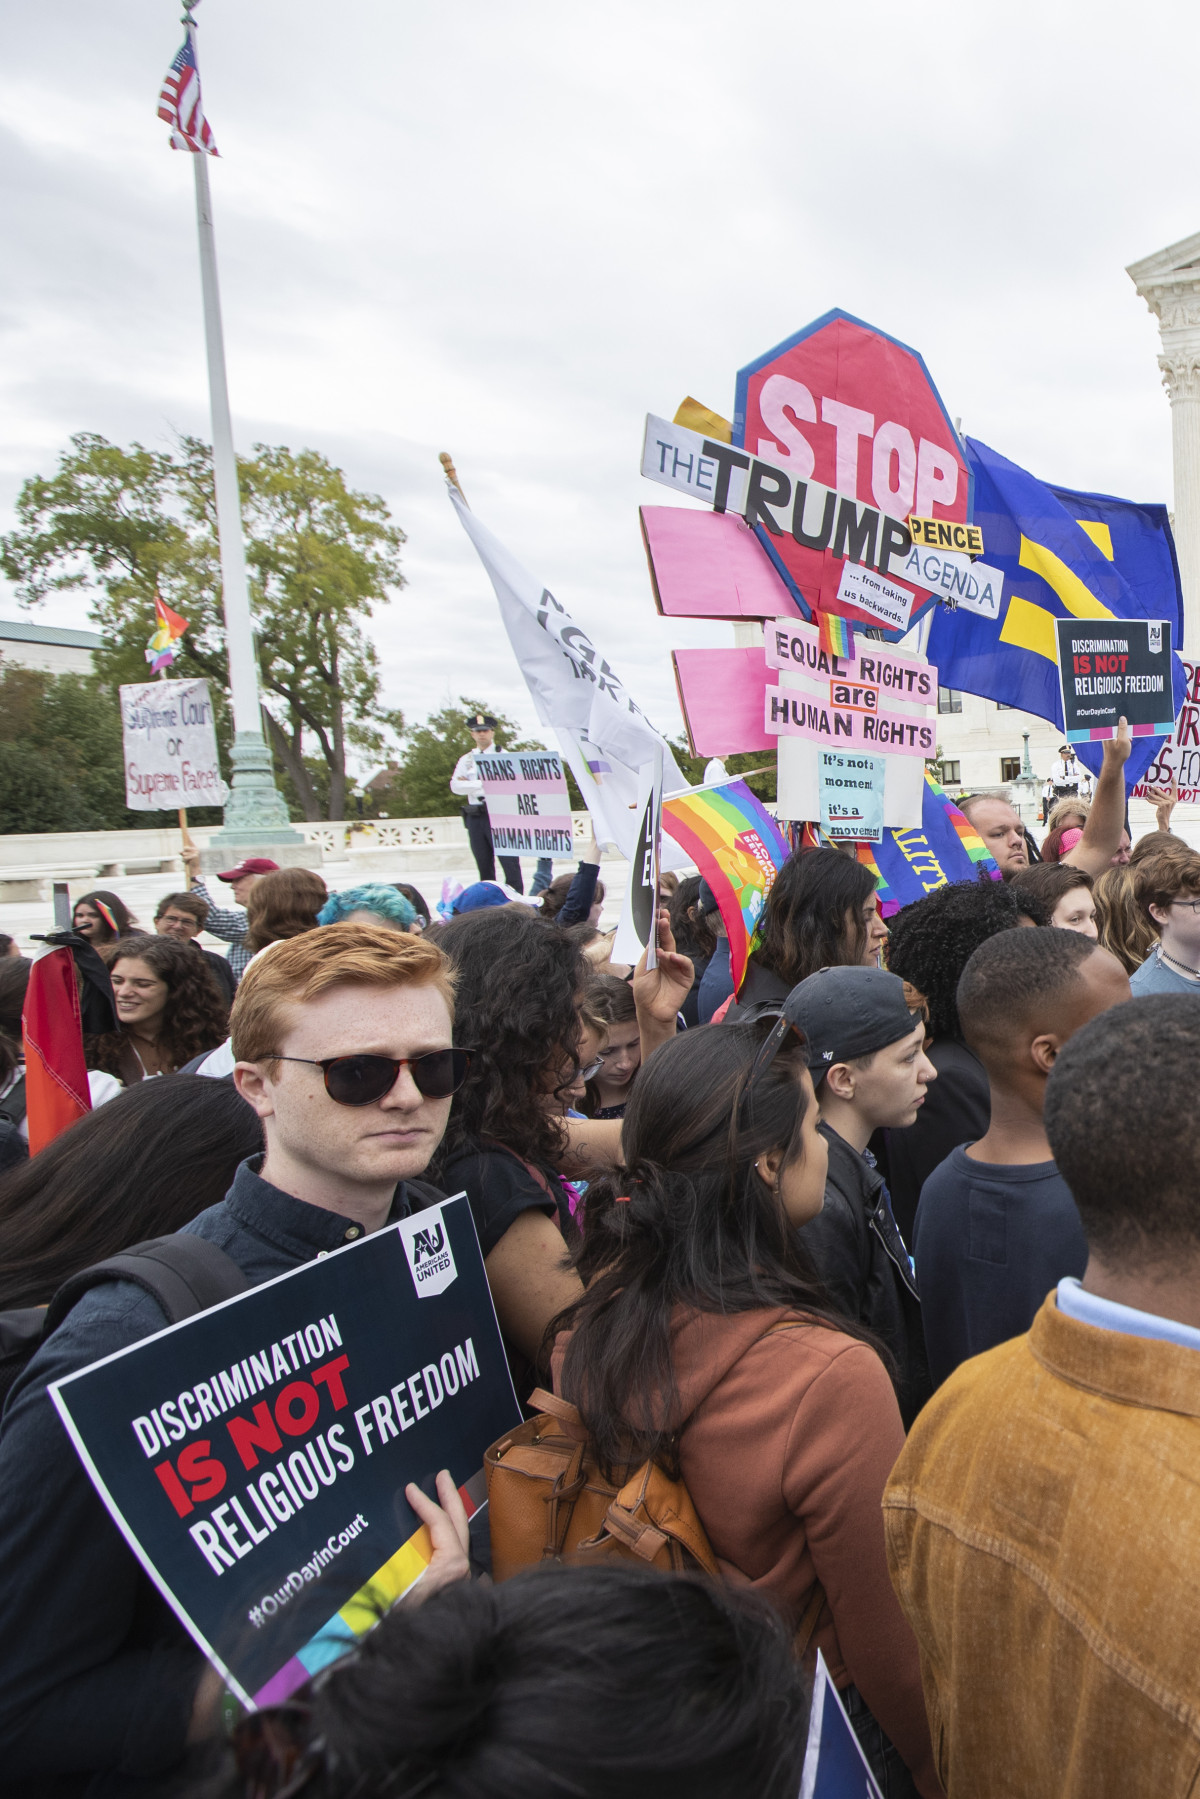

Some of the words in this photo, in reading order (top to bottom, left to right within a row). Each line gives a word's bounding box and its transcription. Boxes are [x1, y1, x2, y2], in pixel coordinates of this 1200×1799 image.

[757, 373, 959, 522] STOP
[656, 440, 715, 492] THE
[701, 439, 912, 575] TRUMP
[911, 518, 981, 551] PENCE
[905, 547, 995, 609] AGENDA
[844, 590, 857, 600] us
[862, 575, 880, 591] from
[882, 586, 908, 607] taking
[1072, 640, 1128, 653] DISCRIMINATION
[775, 630, 847, 678] EQUAL
[860, 656, 931, 695] RIGHTS
[1073, 655, 1091, 674] IS
[1095, 655, 1129, 673] NOT
[834, 685, 876, 708] are
[1075, 675, 1122, 696] RELIGIOUS
[1125, 675, 1164, 693] FREEDOM
[771, 696, 853, 737] HUMAN
[864, 716, 932, 749] RIGHTS
[167, 738, 183, 756] or
[476, 760, 516, 781] TRANS
[519, 758, 562, 780] RIGHTS
[823, 754, 844, 767] It's
[847, 759, 868, 769] not
[128, 762, 179, 803] Supreme
[517, 794, 539, 816] ARE
[828, 804, 848, 815] it's
[851, 807, 860, 815] a
[491, 827, 532, 850] HUMAN
[534, 829, 572, 851] RIGHTS
[416, 1251, 449, 1273] AMERICANS
[417, 1258, 450, 1282] UNITED
[131, 1313, 343, 1458] DISCRIMINATION
[154, 1440, 228, 1519] IS
[226, 1353, 350, 1472] NOT
[188, 1423, 355, 1576] RELIGIOUS
[354, 1337, 481, 1456] FREEDOM
[248, 1513, 369, 1628] #OurDayinCourt
